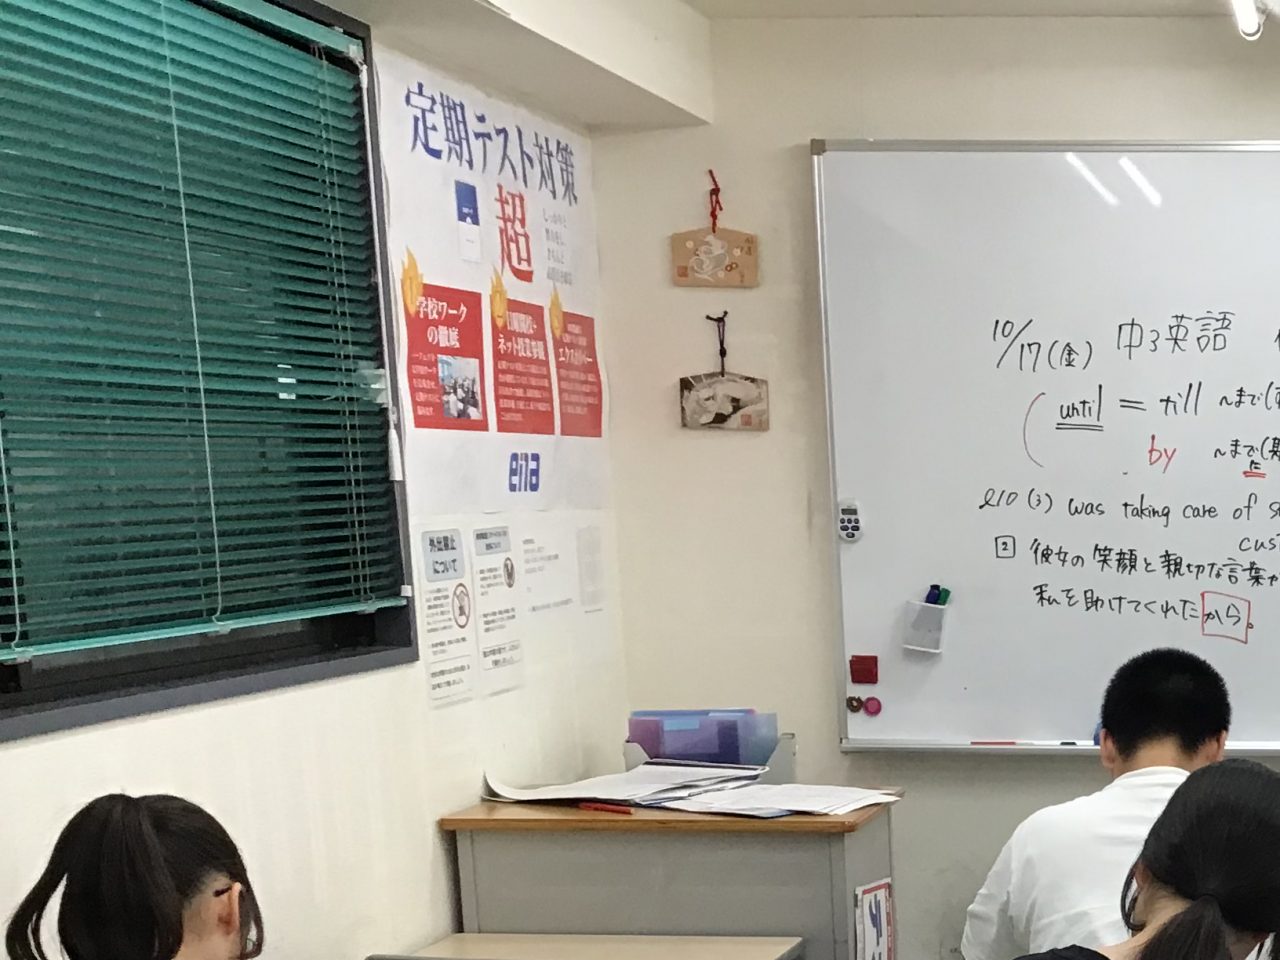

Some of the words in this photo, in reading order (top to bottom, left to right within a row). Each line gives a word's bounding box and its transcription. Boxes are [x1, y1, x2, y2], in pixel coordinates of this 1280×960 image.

[405, 81, 578, 207] 定期テスト対策
[494, 183, 534, 283] 超
[416, 296, 467, 323] 学校ワーク
[1117, 311, 1235, 360] 中3英語
[1060, 384, 1102, 422] until
[1160, 381, 1202, 416] till
[508, 452, 540, 492] ena
[1149, 434, 1177, 473] by
[1069, 498, 1105, 517] was
[1123, 494, 1170, 528] taking
[1183, 502, 1218, 520] care
[1233, 493, 1257, 520] of
